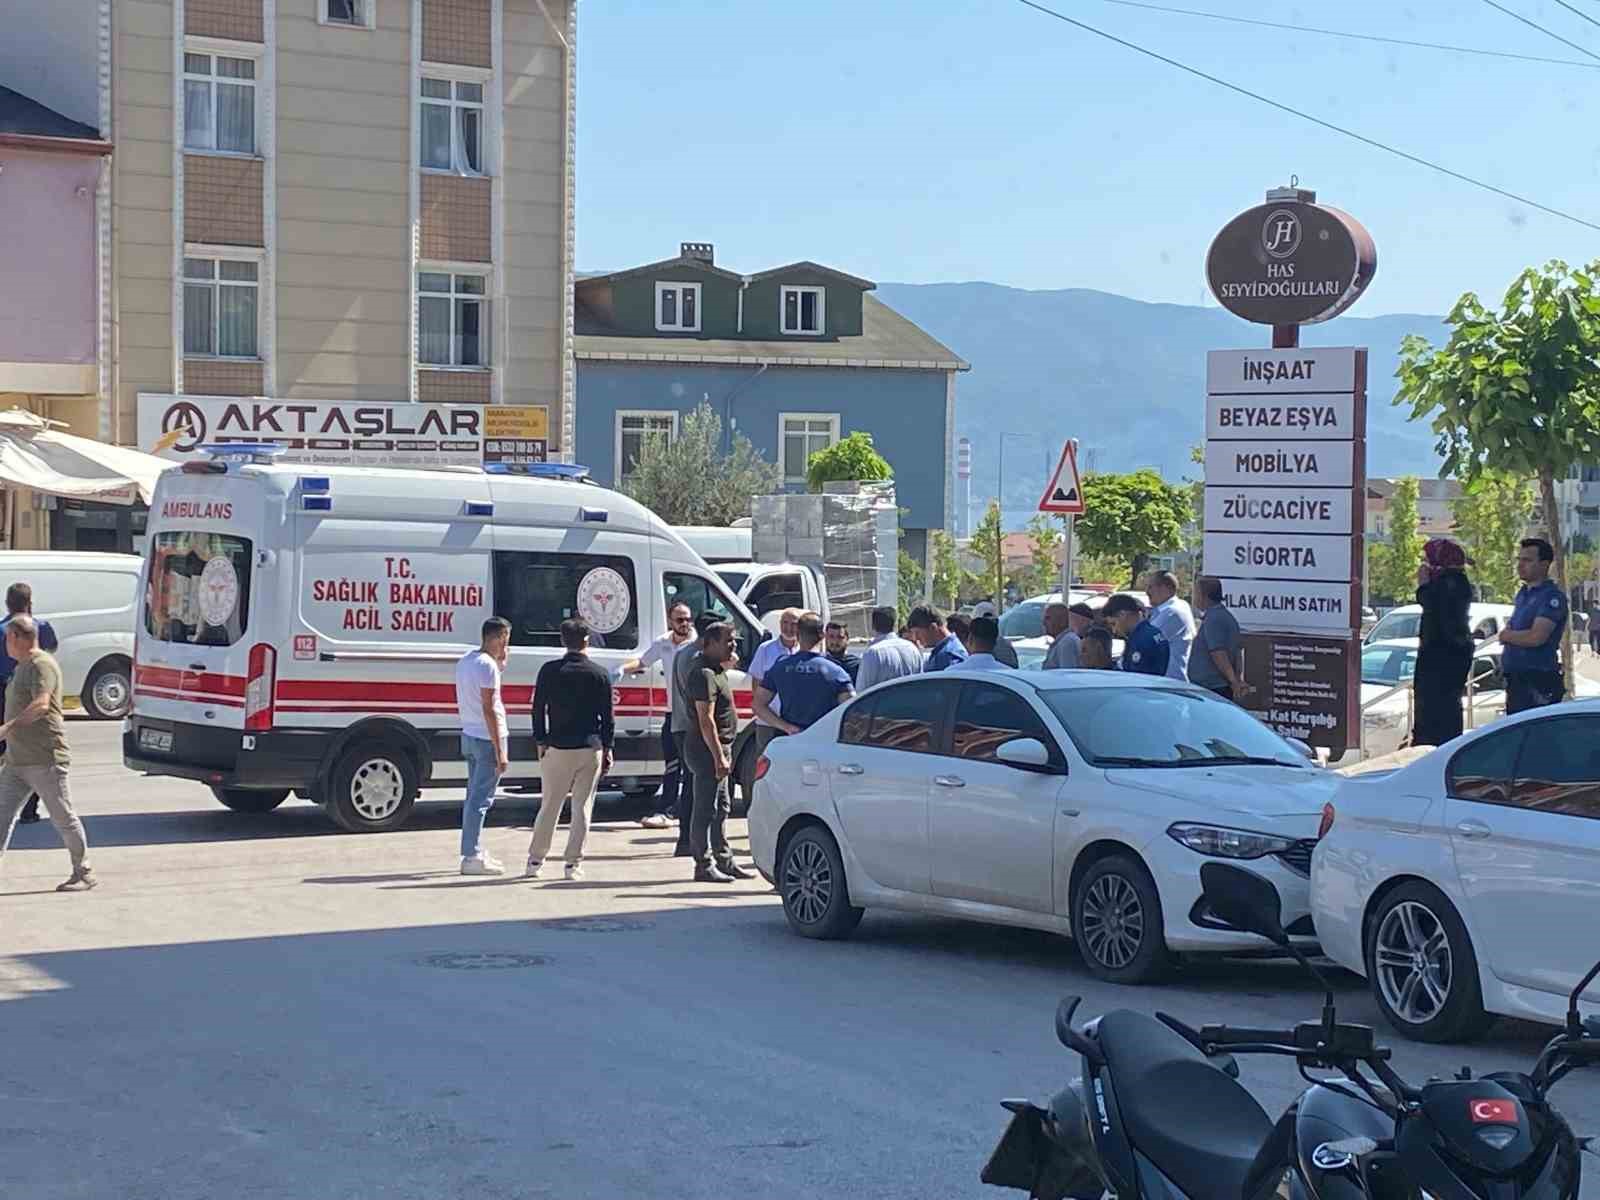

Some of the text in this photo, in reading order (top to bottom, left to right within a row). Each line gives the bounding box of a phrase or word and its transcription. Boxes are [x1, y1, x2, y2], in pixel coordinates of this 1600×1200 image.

[1267, 263, 1295, 278] HAS
[1220, 279, 1340, 298] SEYYİDOĞULLARI
[1243, 356, 1315, 384] İNŞAAT
[216, 402, 480, 437] AKTAŞLAR
[1219, 406, 1338, 431] BEYAZ EŞYA
[1235, 448, 1319, 474] MOBİLYA
[161, 501, 233, 520] AMBULANS
[1223, 494, 1331, 520] ZÜCCACİYE
[1234, 540, 1317, 567] SİGORTA
[385, 557, 417, 579] T.C.
[313, 579, 484, 608] SAĞLIK BAKANLIĞI
[1221, 594, 1343, 614] MLAK ALIM SATIM
[342, 606, 454, 633] ACİL SAĞLIK
[296, 638, 314, 650] 112
